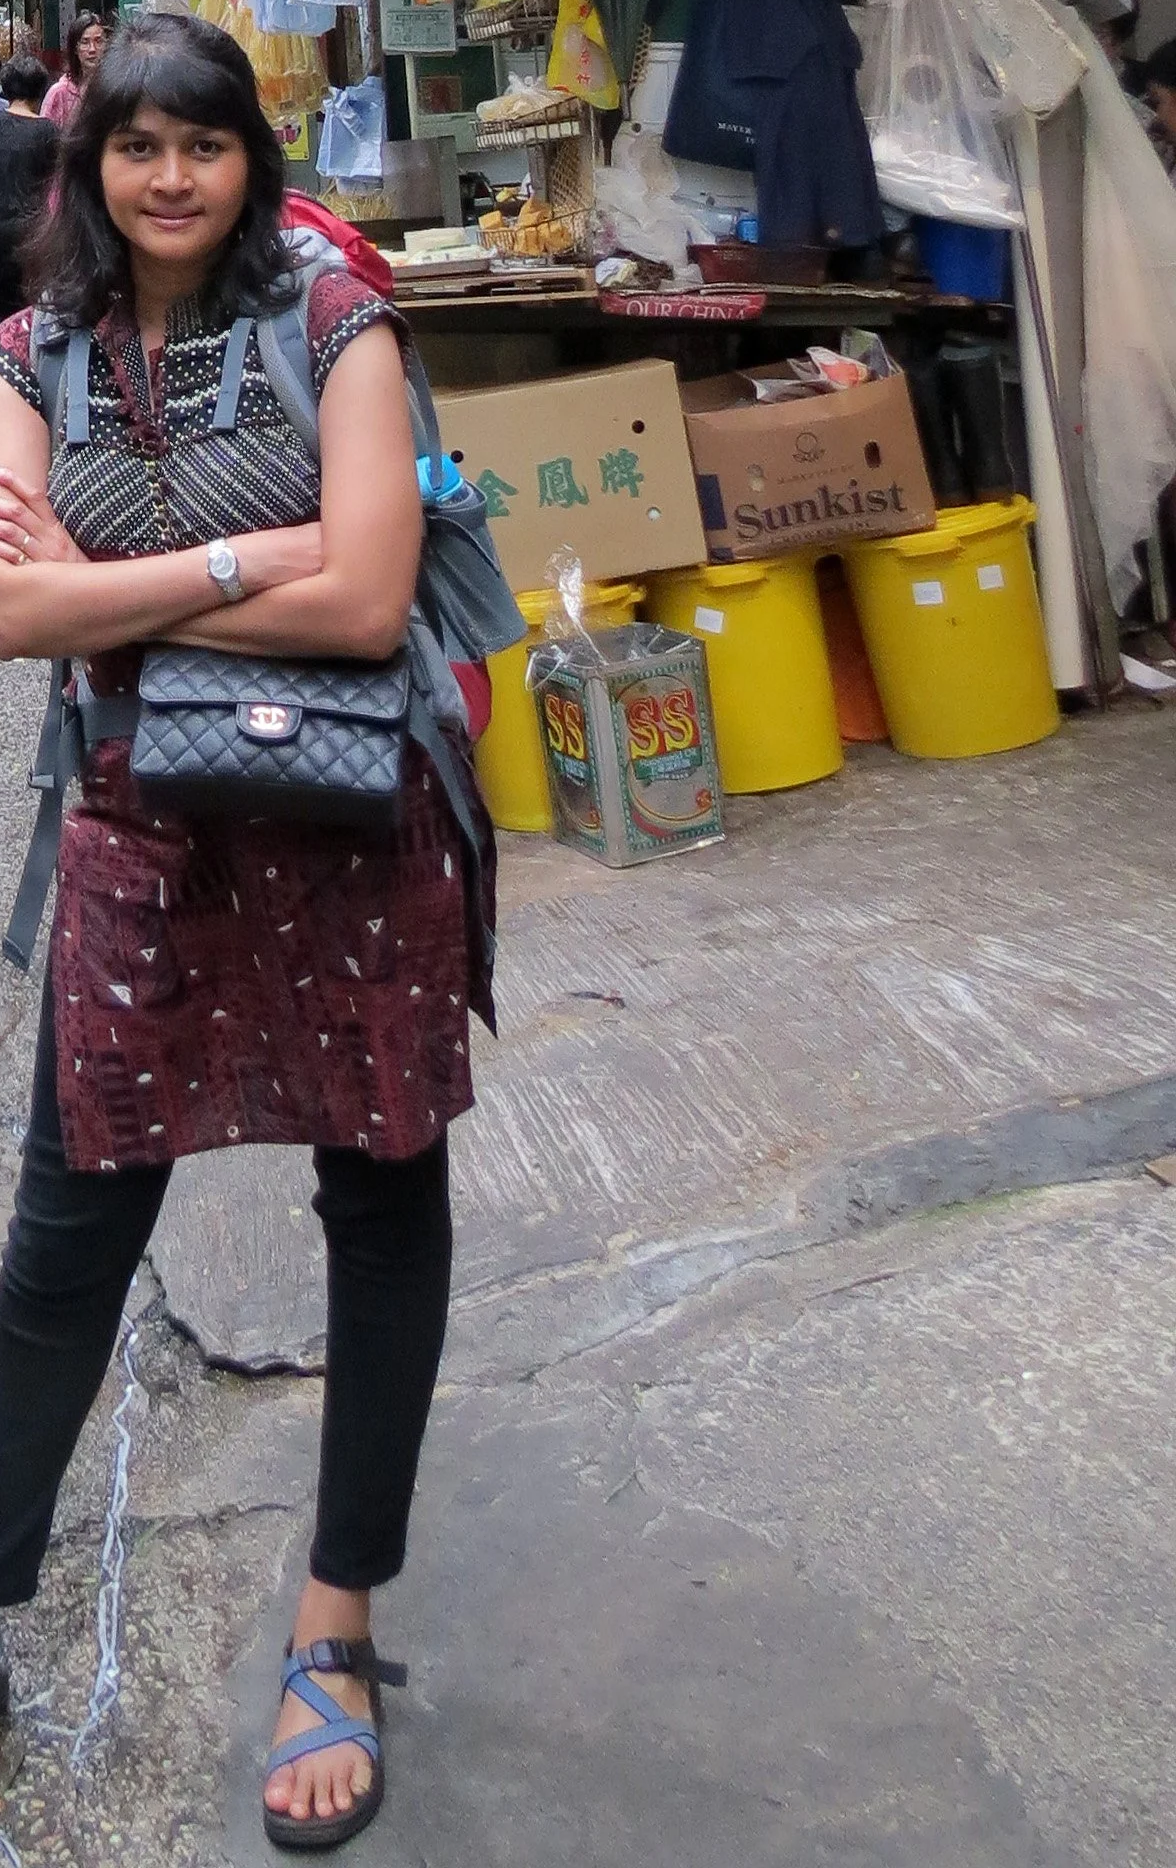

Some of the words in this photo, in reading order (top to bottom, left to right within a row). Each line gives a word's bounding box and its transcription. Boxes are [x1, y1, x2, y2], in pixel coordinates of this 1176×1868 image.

[476, 448, 645, 518] 金鳳牌
[734, 478, 907, 540] Sunkist
[545, 693, 585, 760] SS
[628, 689, 695, 759] SS
